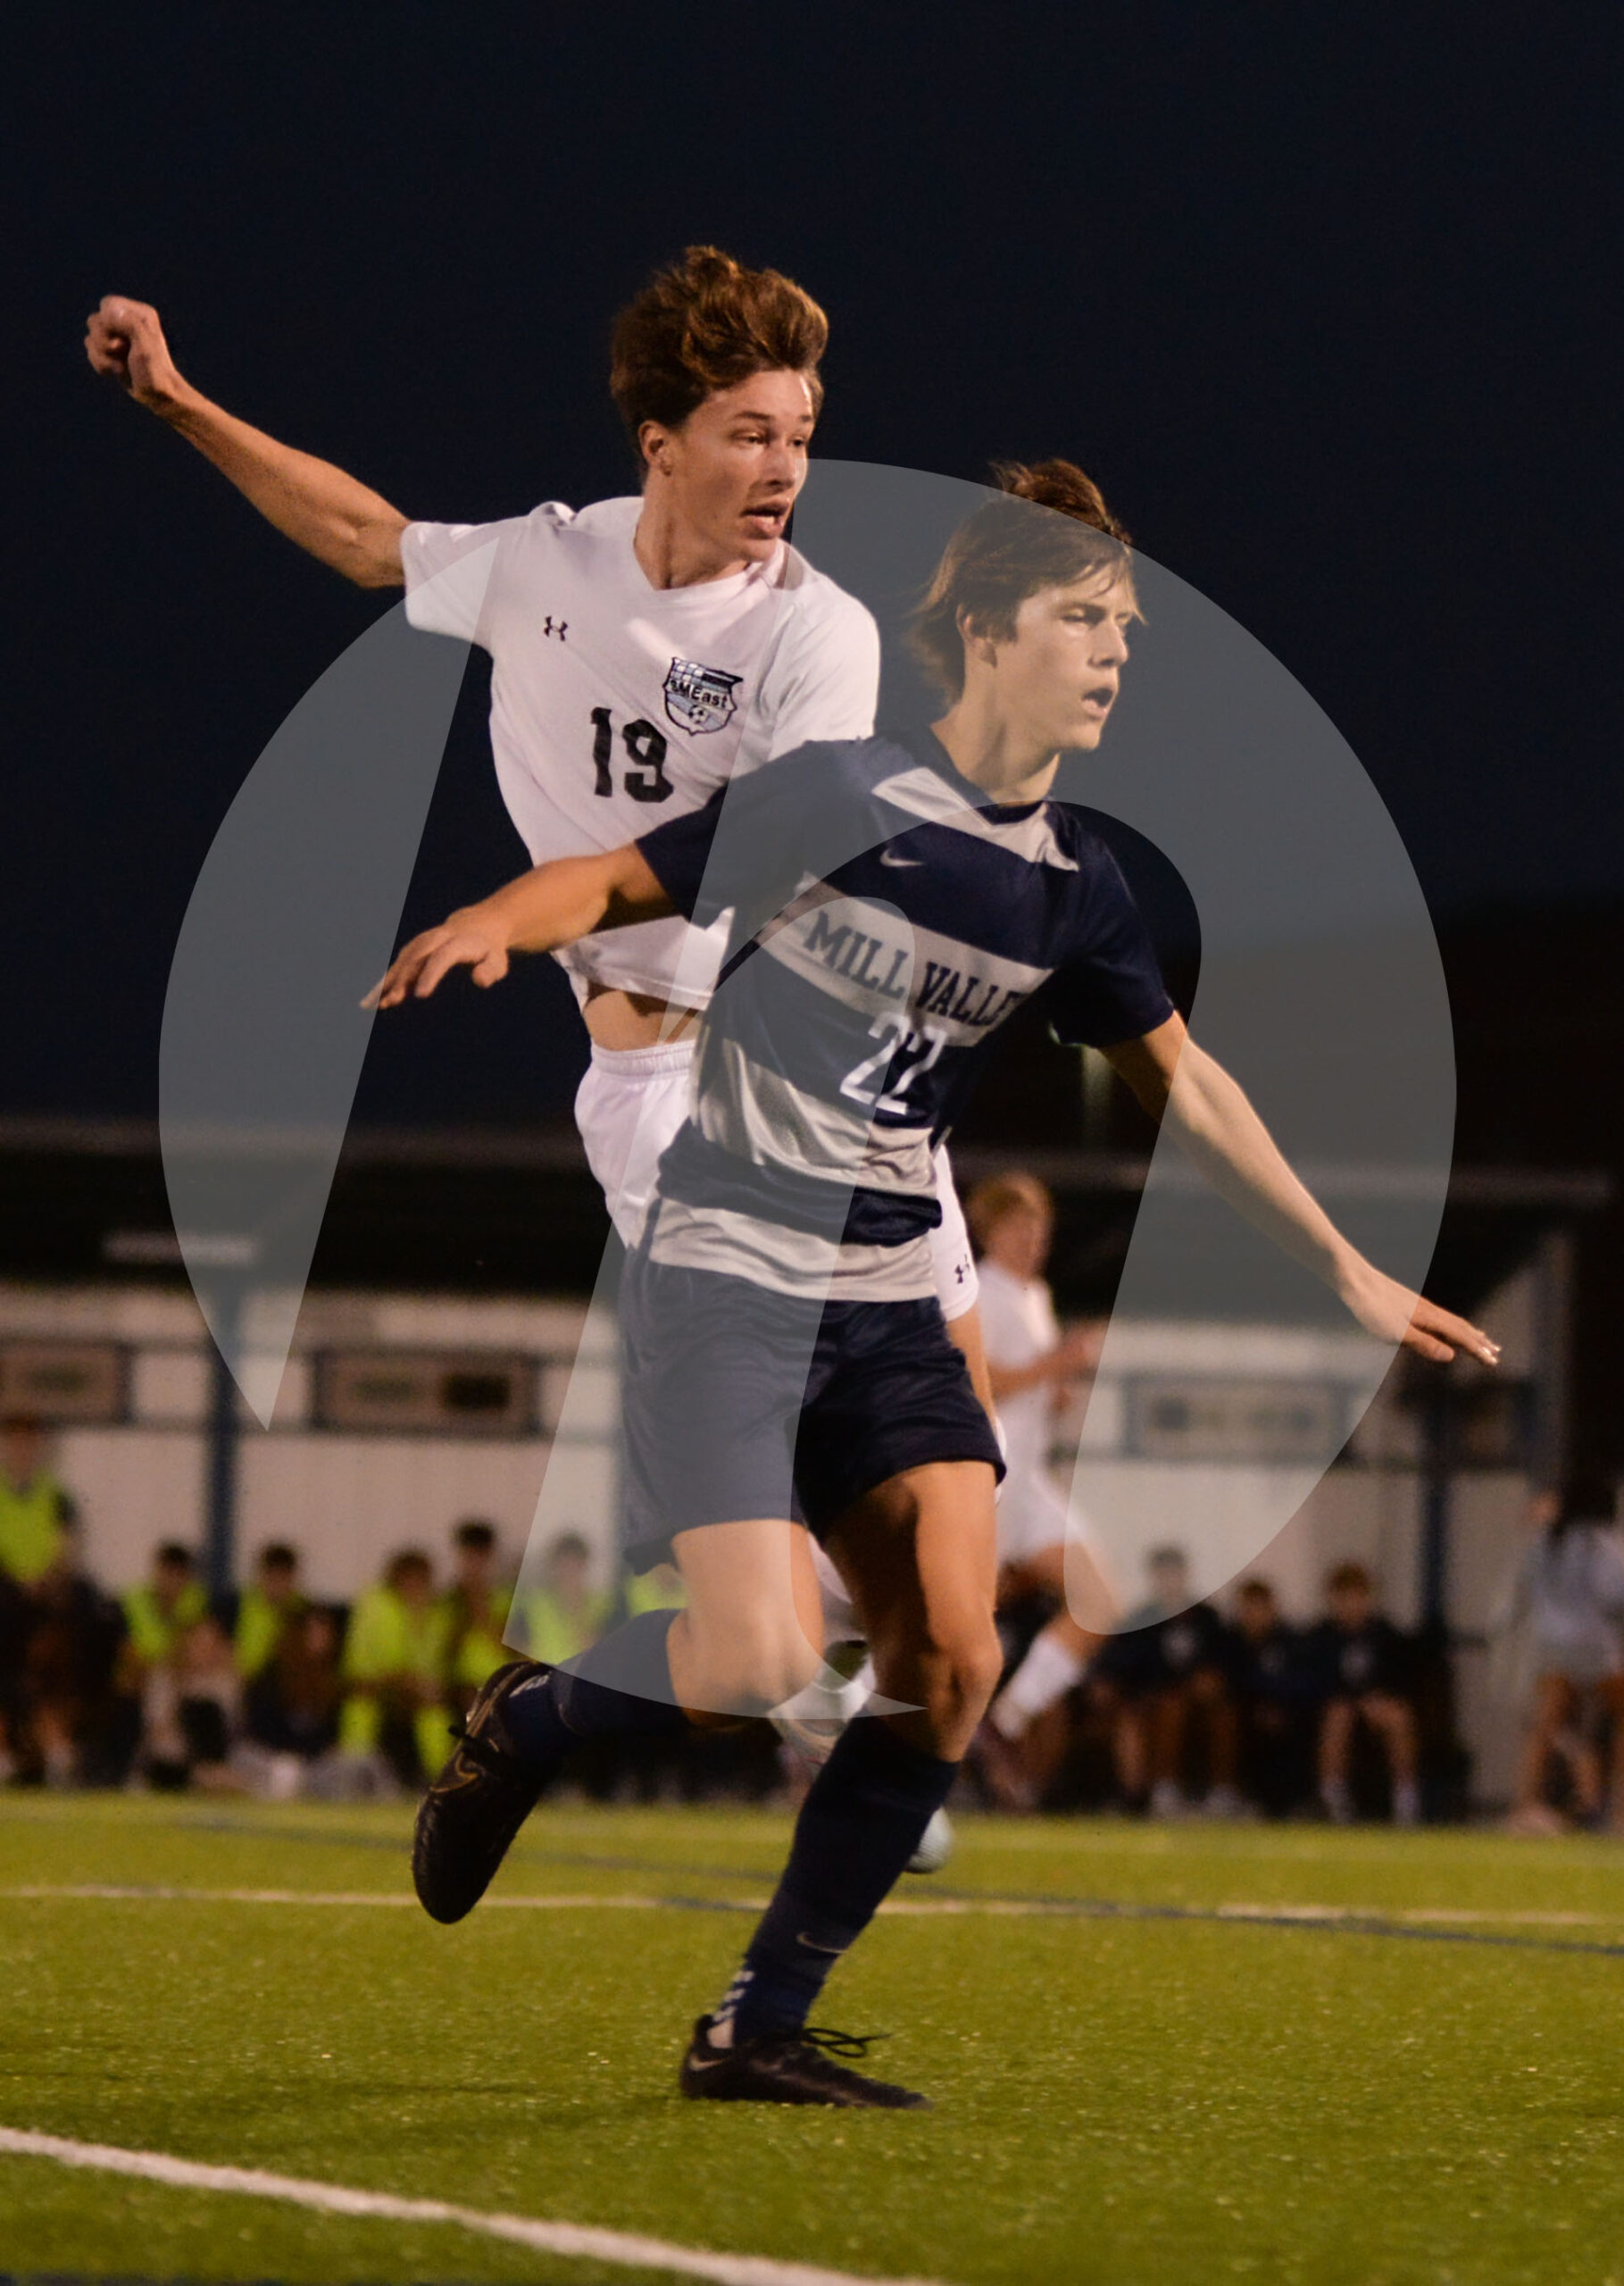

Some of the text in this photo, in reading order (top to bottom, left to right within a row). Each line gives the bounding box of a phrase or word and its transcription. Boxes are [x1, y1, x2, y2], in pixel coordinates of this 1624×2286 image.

[590, 706, 674, 803] 19
[803, 910, 909, 999] MILL
[840, 1011, 948, 1115] 22
